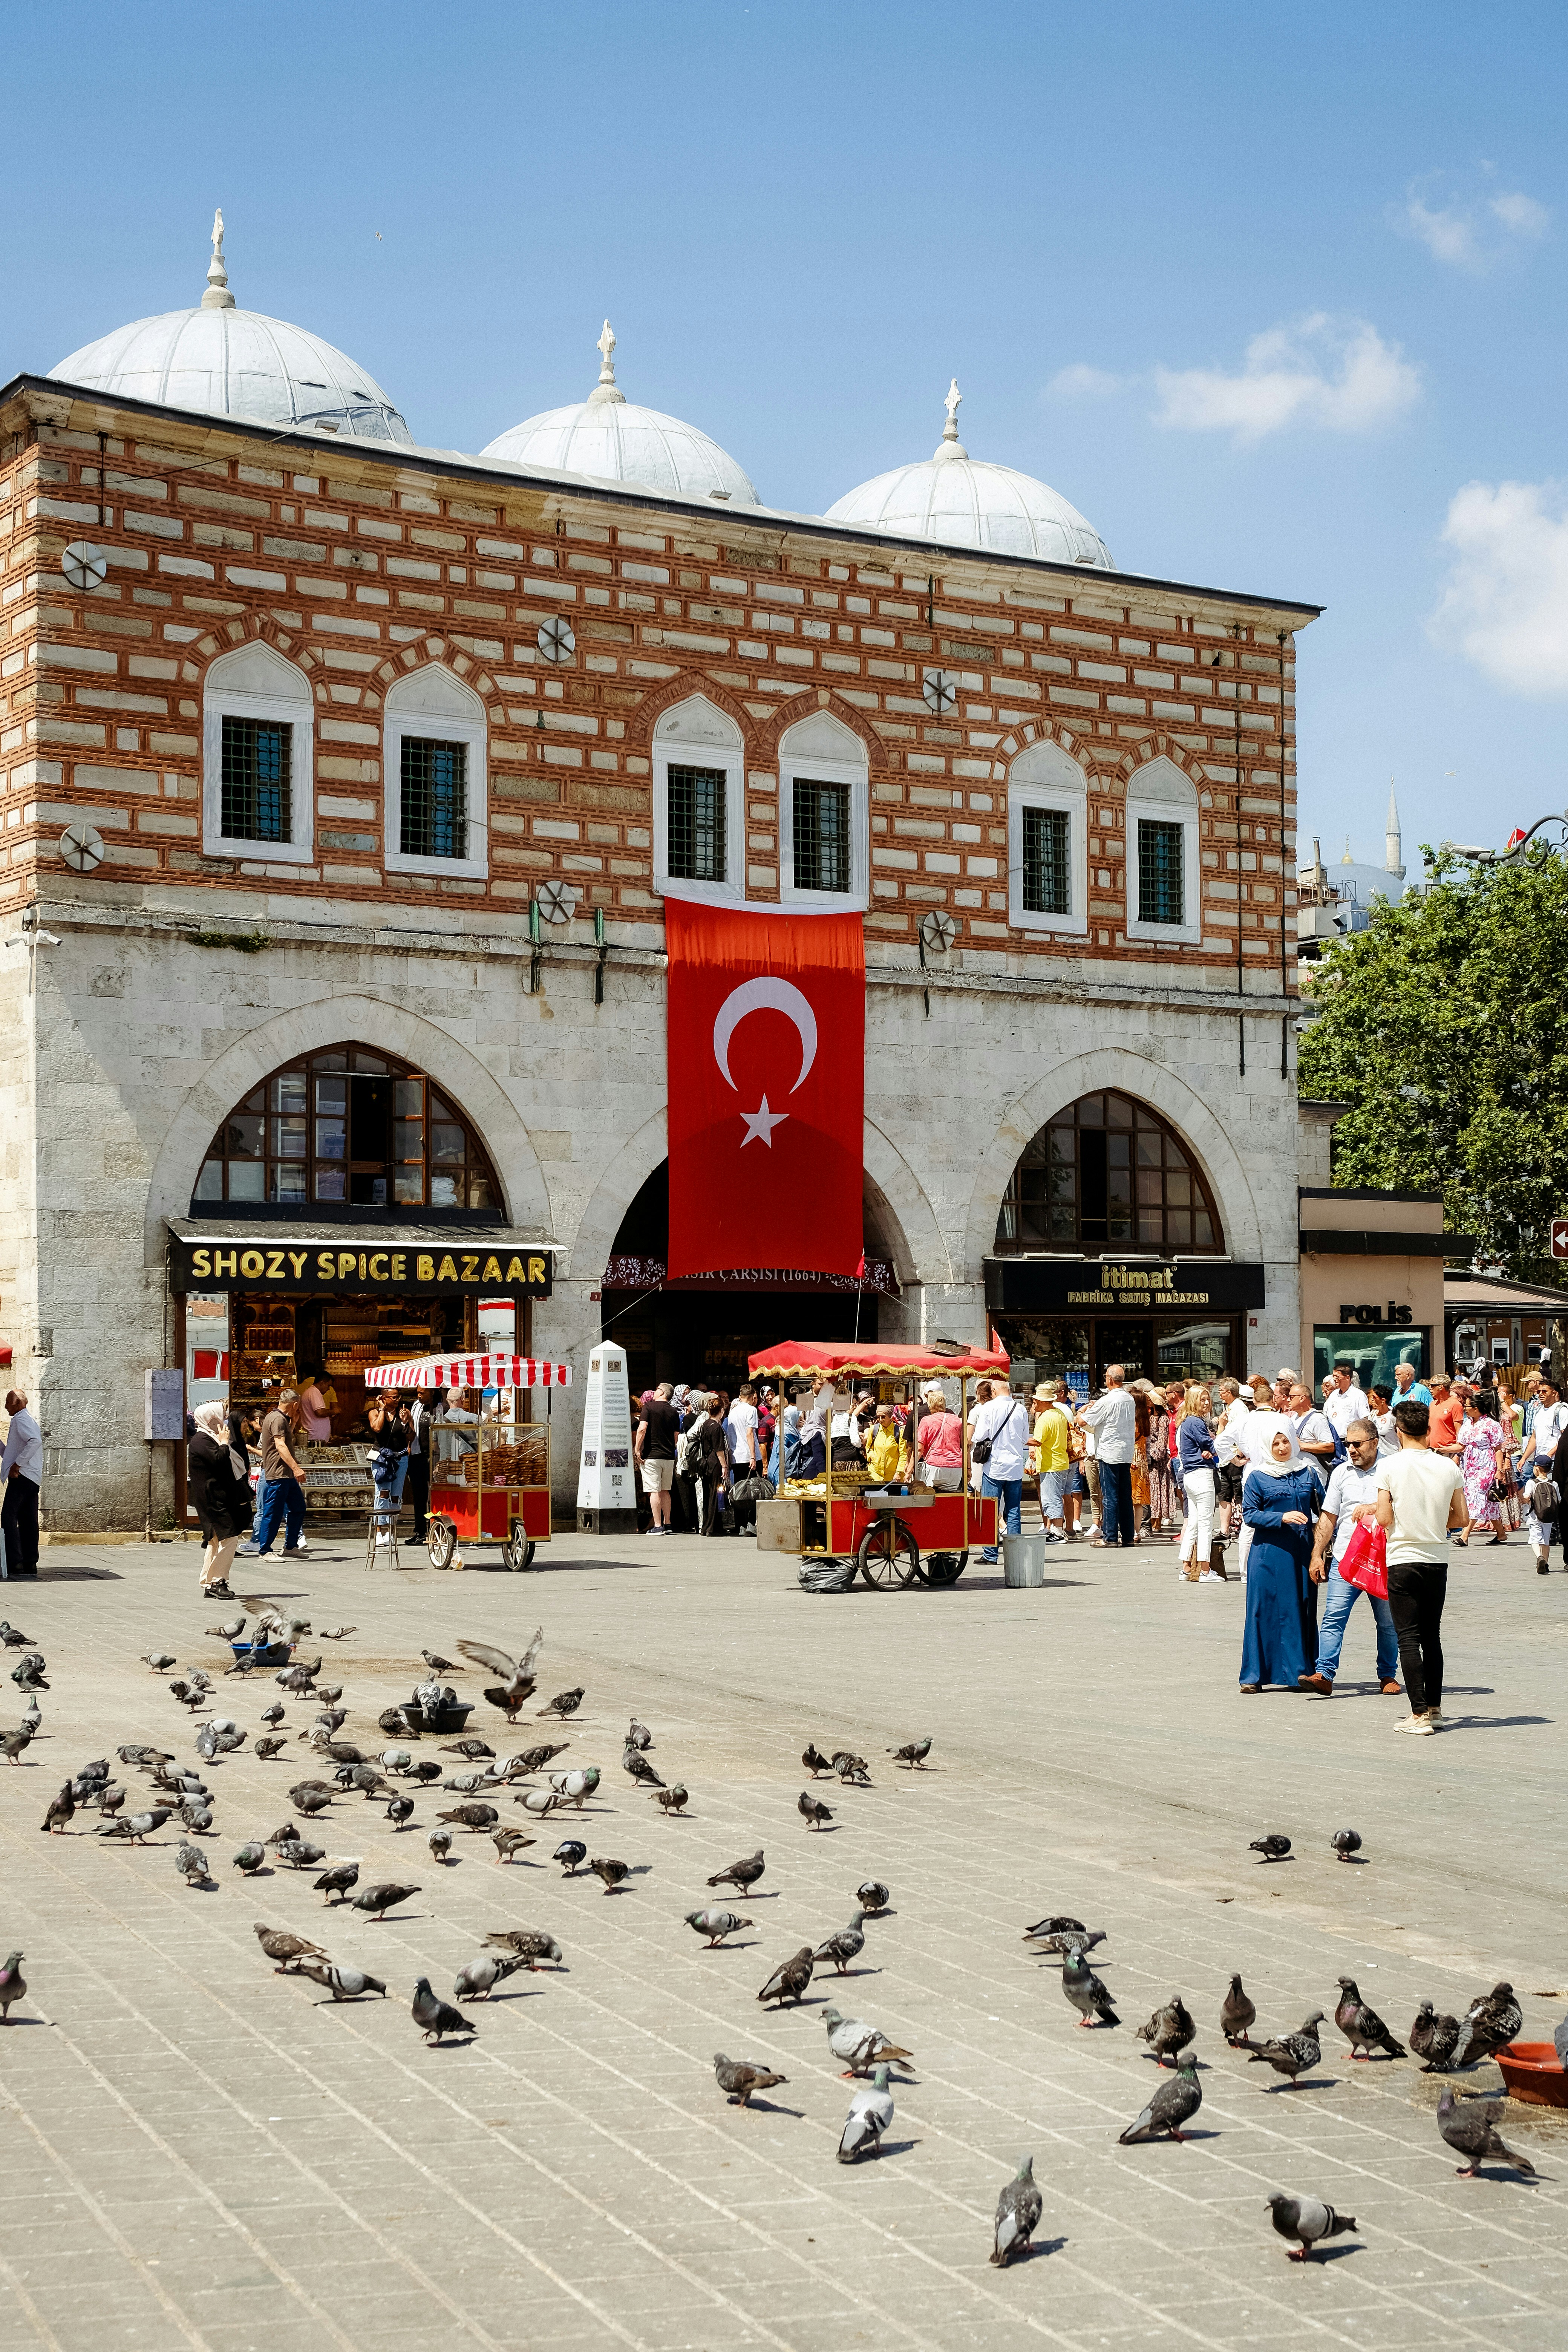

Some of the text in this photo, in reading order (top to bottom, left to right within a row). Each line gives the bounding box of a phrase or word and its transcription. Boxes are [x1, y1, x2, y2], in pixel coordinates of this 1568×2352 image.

[192, 1250, 546, 1283] SHOZY SPICE BAZAAR
[782, 1269, 821, 1283] (1664)
[1101, 1265, 1174, 1288] itimat
[1067, 1289, 1209, 1306] FABRİKA SATIŞ MAĞAZASI
[1340, 1300, 1413, 1324] POLİS
